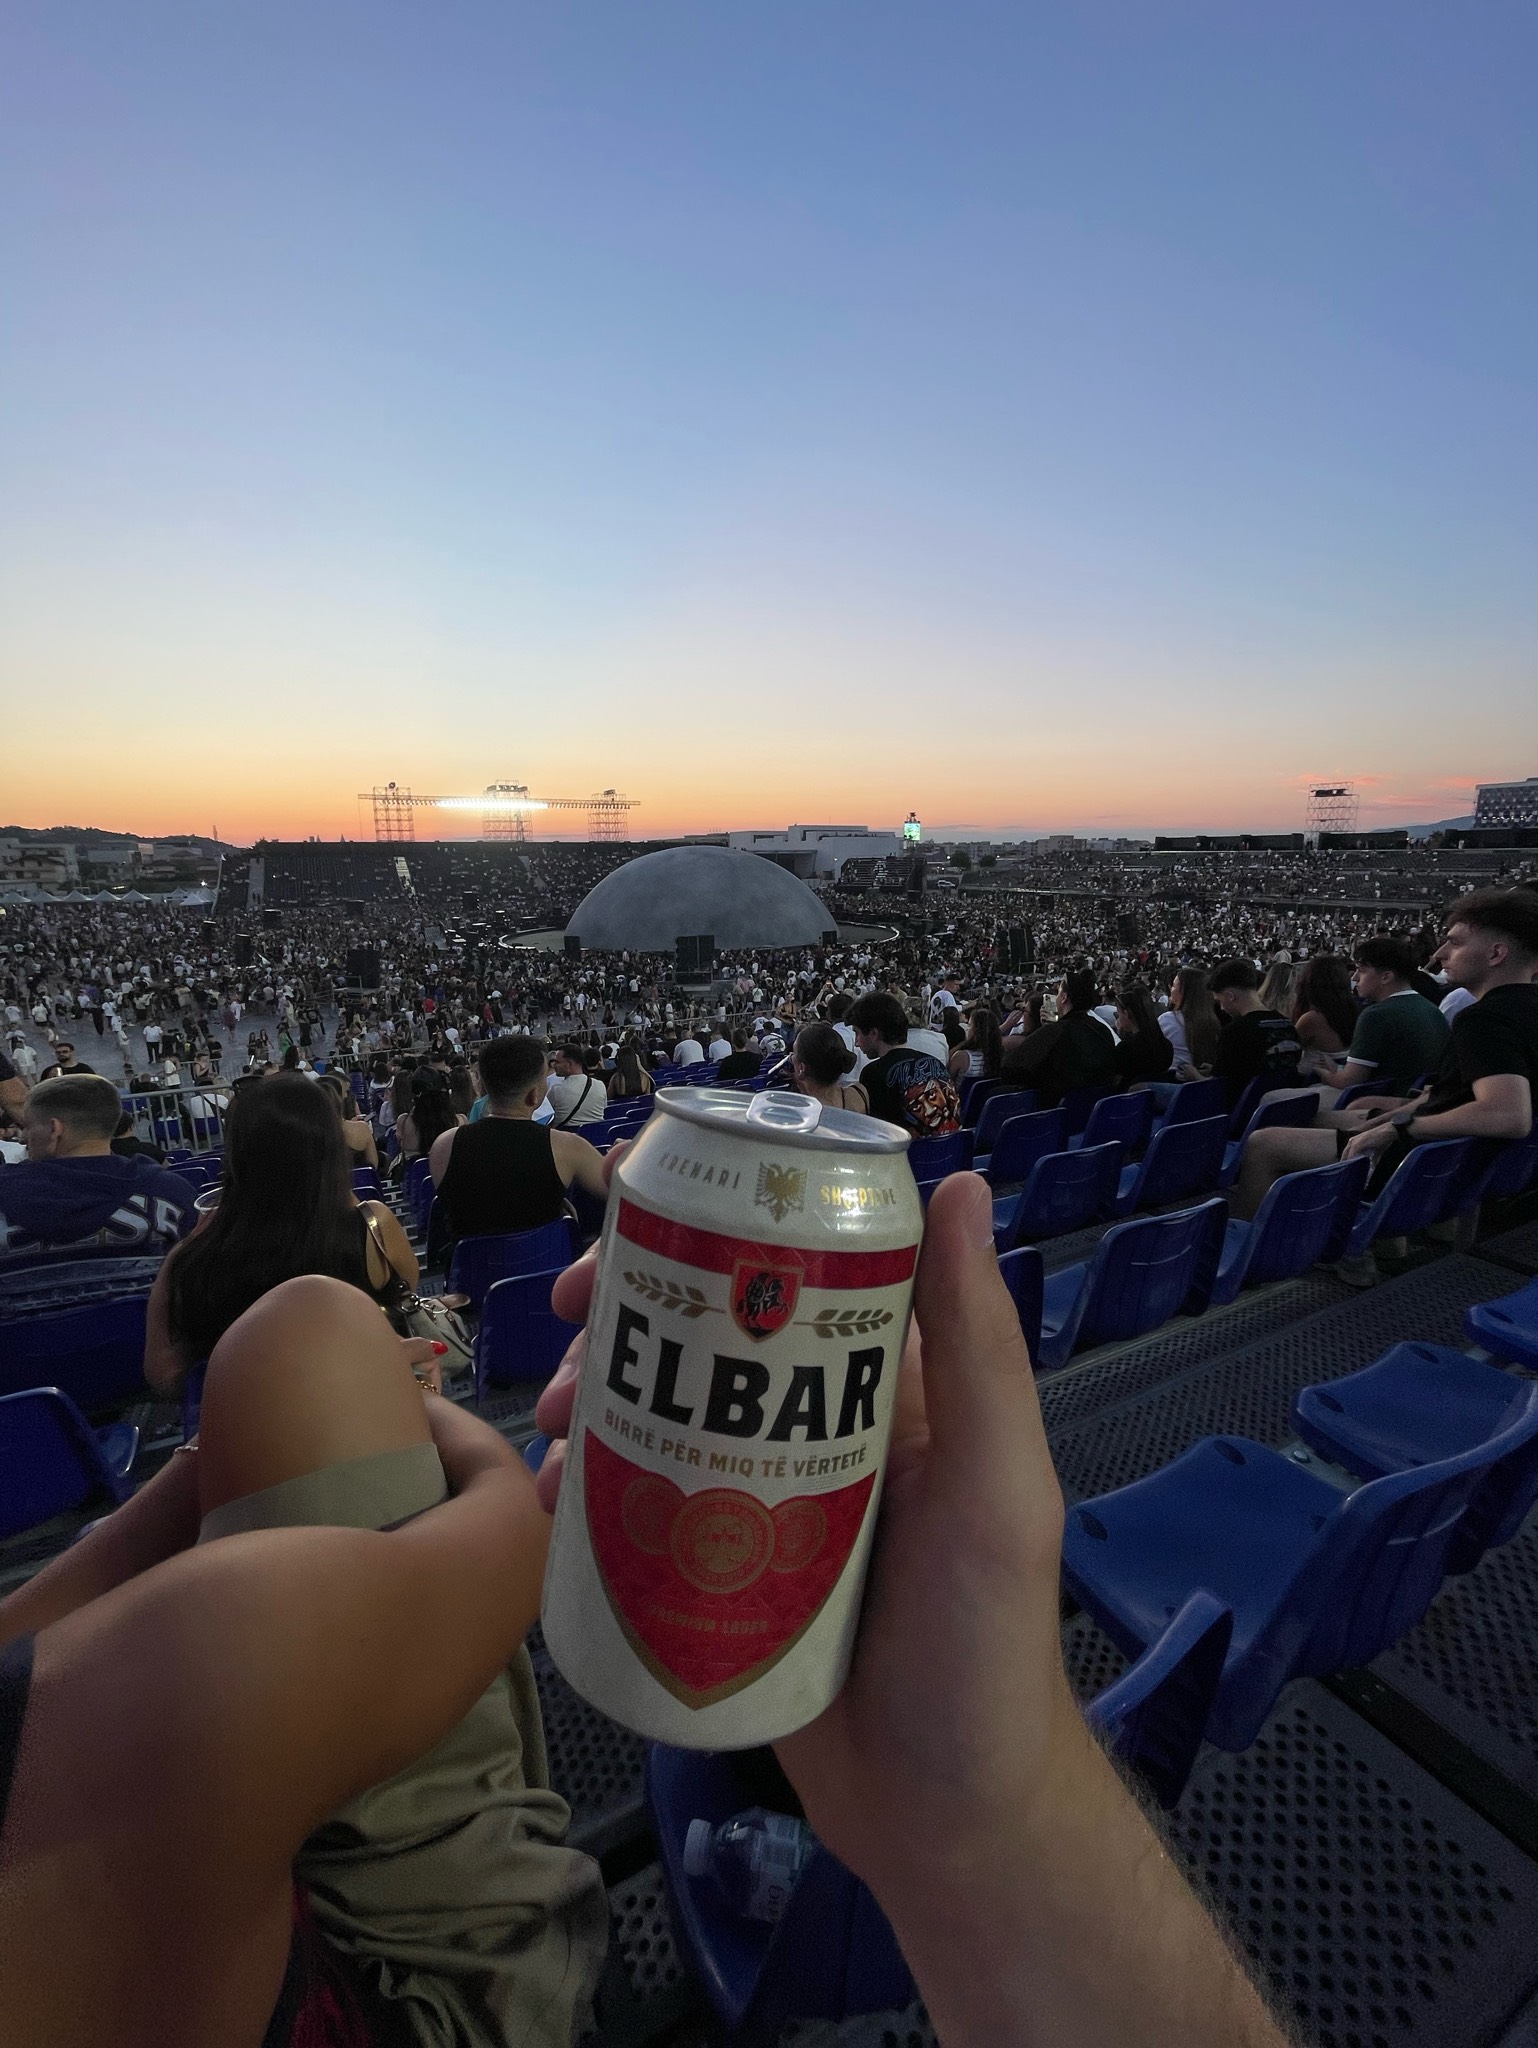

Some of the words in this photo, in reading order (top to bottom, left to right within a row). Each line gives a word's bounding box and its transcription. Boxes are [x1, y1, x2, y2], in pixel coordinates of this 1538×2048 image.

[658, 1152, 741, 1190] KRENARI
[606, 1301, 884, 1442] ELBAR
[604, 1408, 655, 1450] BIRRË
[660, 1438, 702, 1467] PËR
[708, 1452, 754, 1478] MIQ
[762, 1456, 786, 1478] TË
[793, 1443, 868, 1478] VËRTETË
